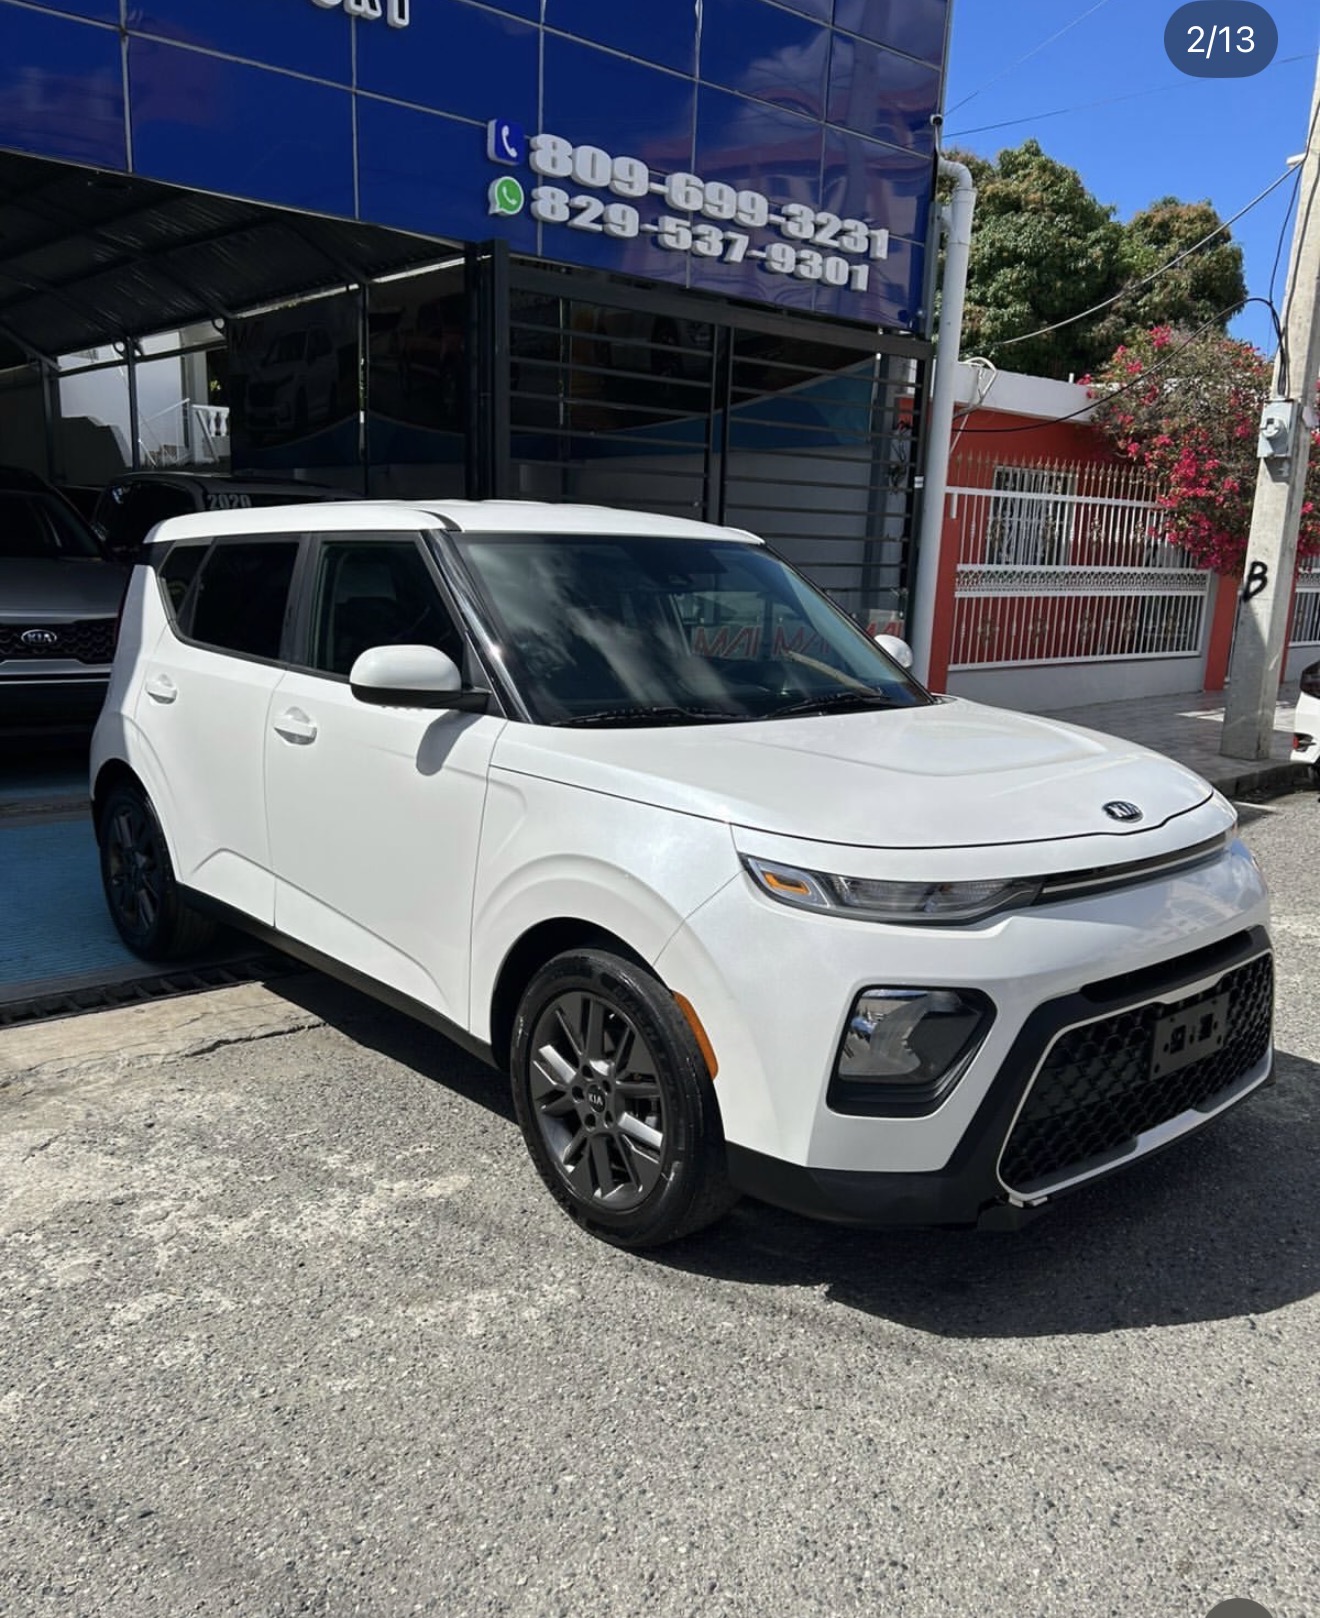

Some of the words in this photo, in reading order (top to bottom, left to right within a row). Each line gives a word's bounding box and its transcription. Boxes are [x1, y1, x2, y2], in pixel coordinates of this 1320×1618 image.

[529, 133, 889, 260] 809-699-3231
[531, 186, 869, 292] 829-537-9301
[207, 494, 252, 510] 2020
[1241, 561, 1268, 603] B
[25, 631, 53, 644] KIA
[588, 1092, 604, 1106] KIA
